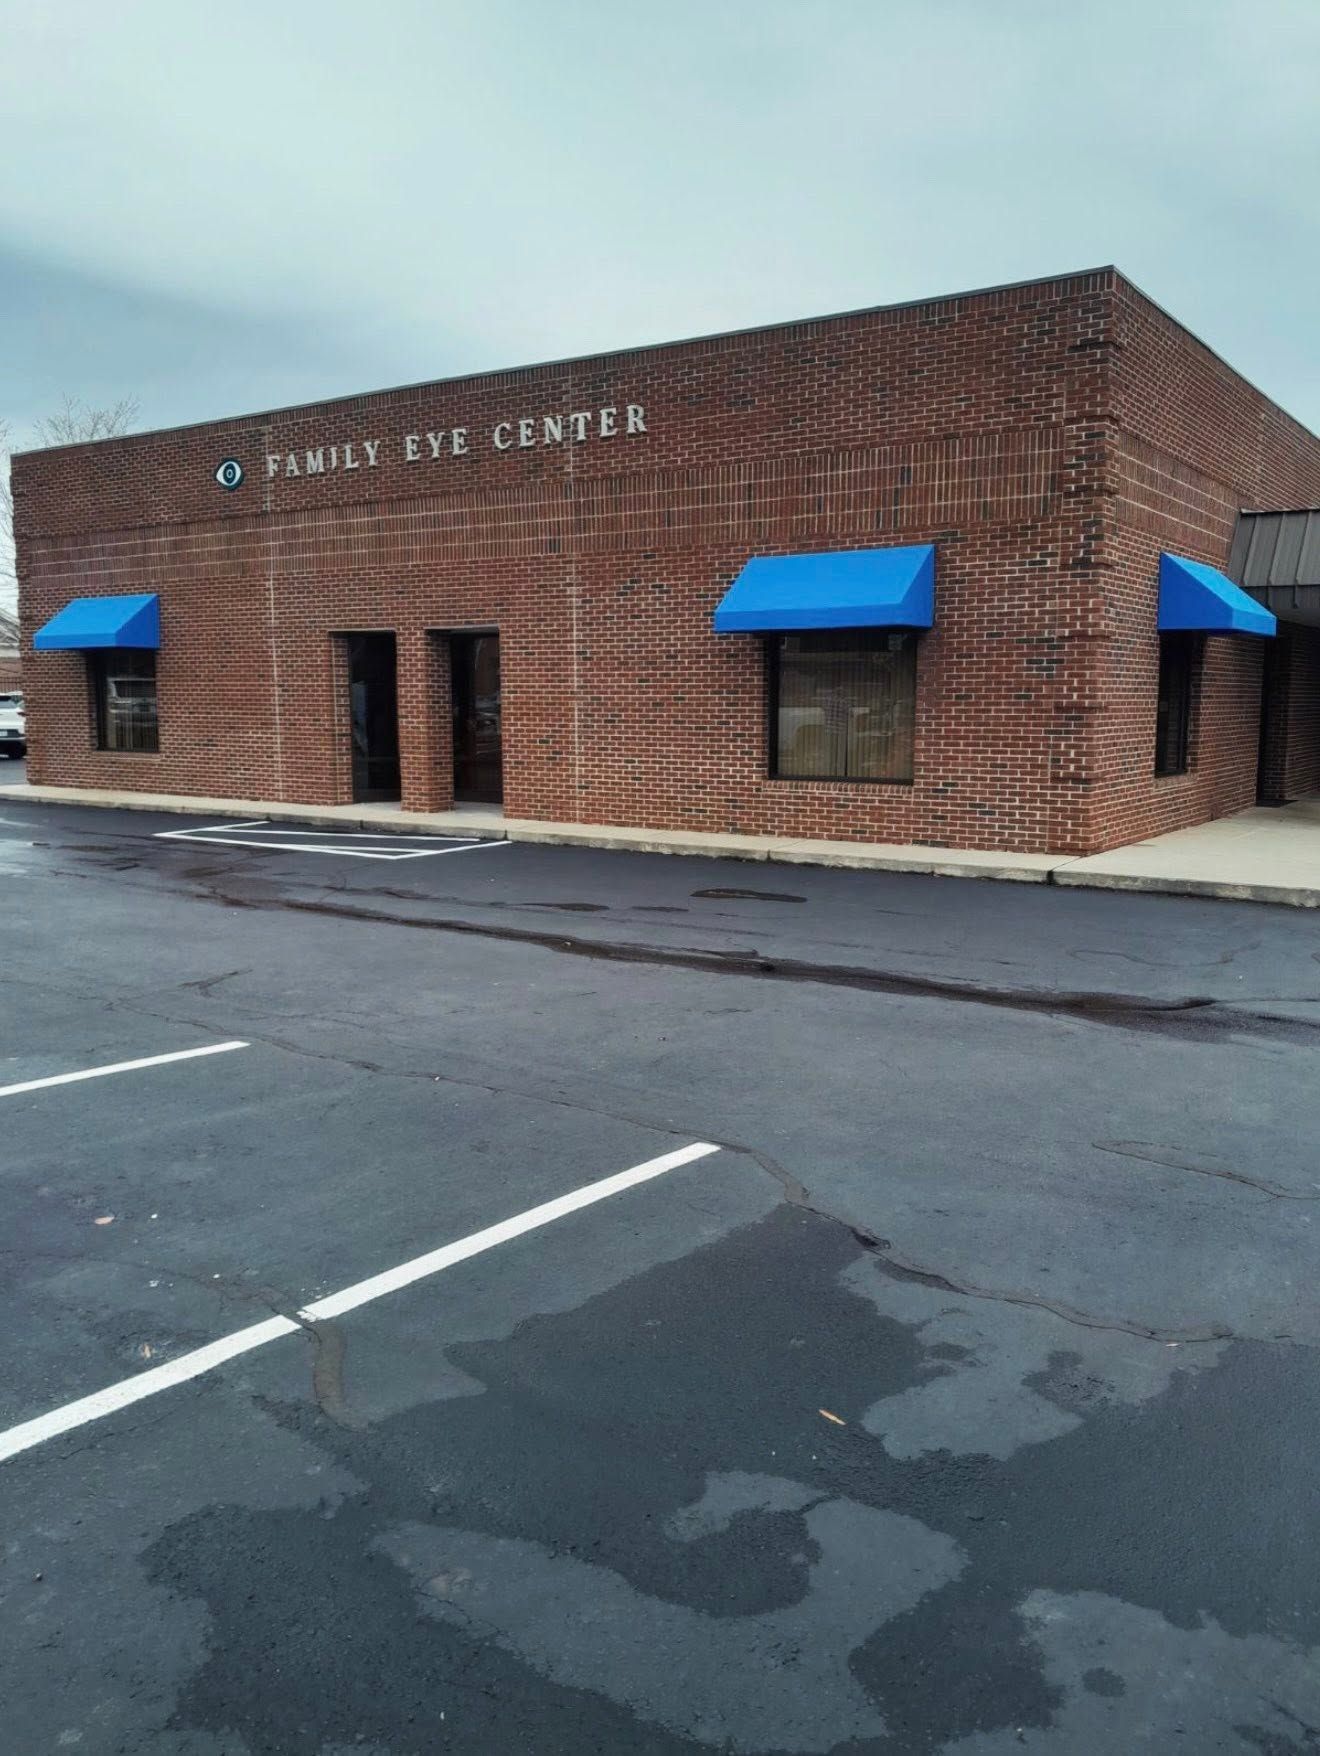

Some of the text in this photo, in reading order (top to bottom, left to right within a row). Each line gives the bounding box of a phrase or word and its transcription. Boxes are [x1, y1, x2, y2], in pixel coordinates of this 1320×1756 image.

[266, 404, 649, 478] FAMILY EYE CENTER
